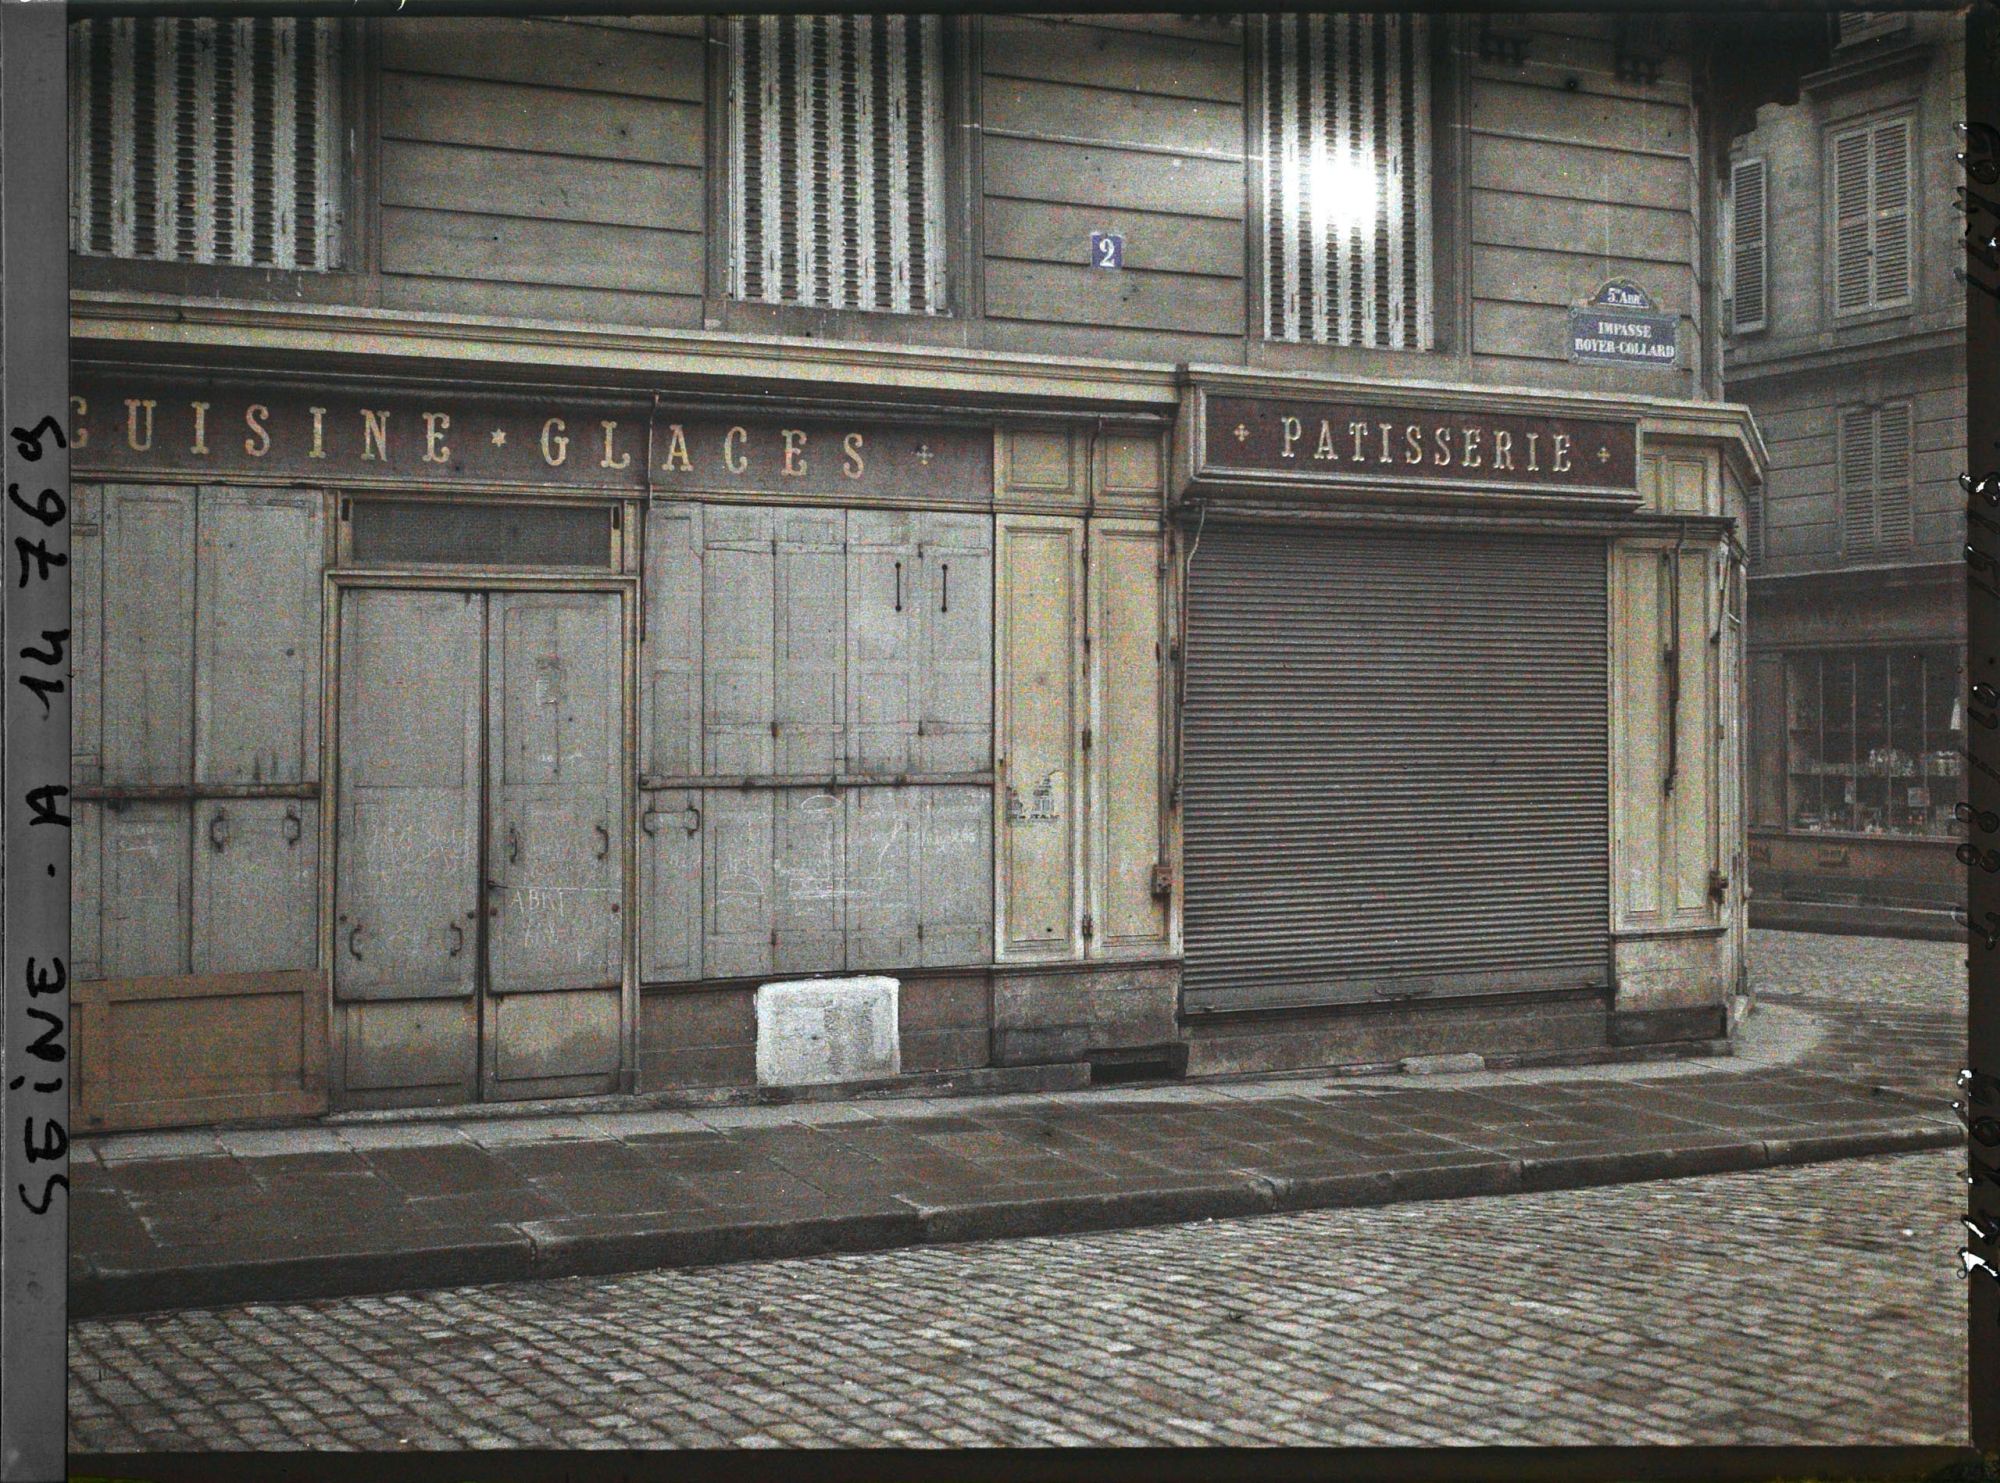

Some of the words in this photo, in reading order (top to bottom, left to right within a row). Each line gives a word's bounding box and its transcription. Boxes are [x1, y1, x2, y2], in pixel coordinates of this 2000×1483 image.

[1099, 238, 1115, 268] 2
[1574, 337, 1676, 358] ROYER-COLLARD
[1598, 320, 1652, 339] IMPASSE
[71, 395, 451, 464] CUISINE
[540, 417, 865, 480] GLACES
[1280, 416, 1572, 473] PATISSERIE
[25, 785, 70, 827] A
